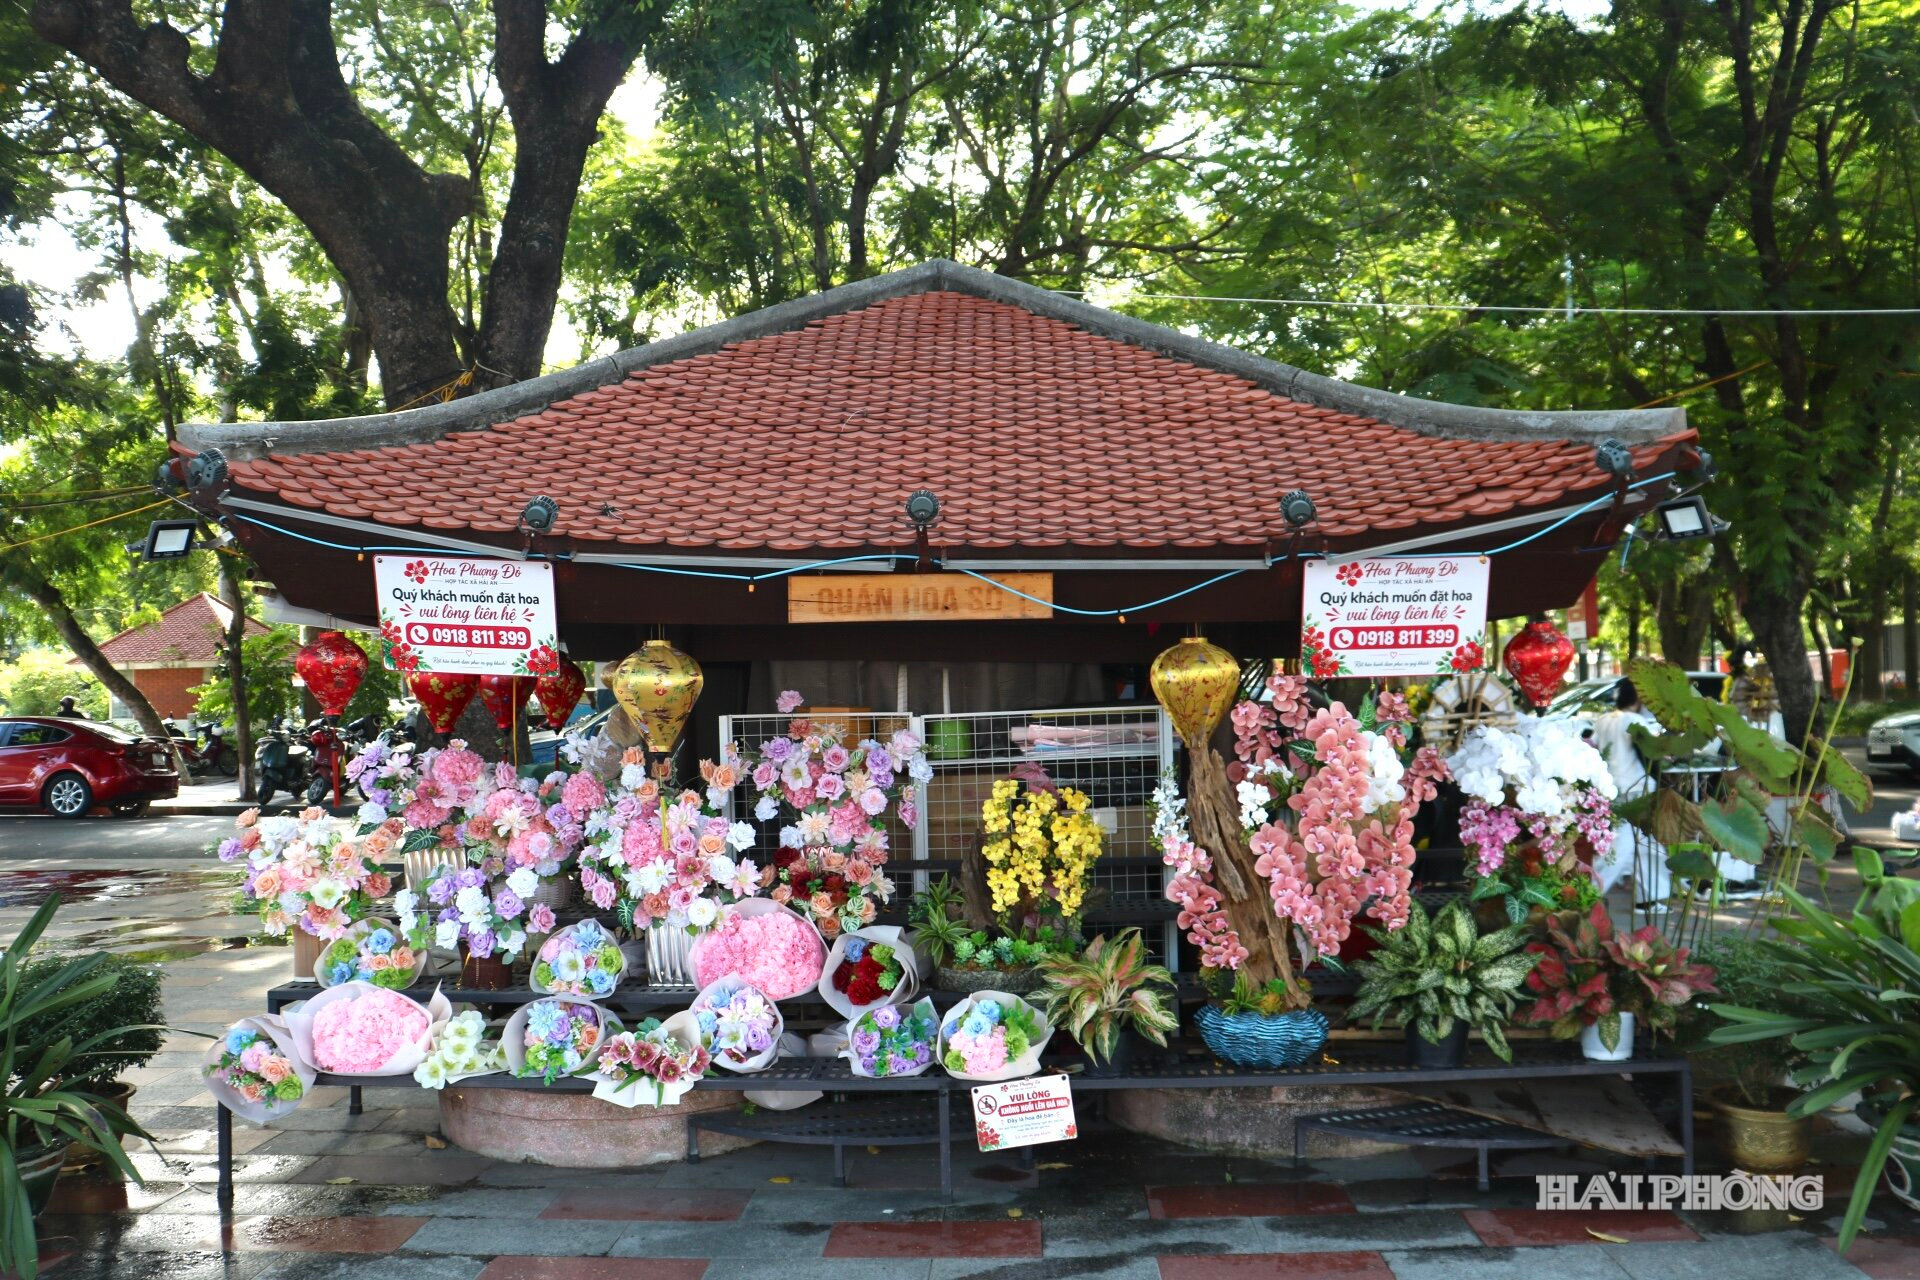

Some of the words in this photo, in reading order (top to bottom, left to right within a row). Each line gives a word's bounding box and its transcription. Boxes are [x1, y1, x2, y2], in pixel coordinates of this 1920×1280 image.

[429, 561, 456, 576] Hoa
[501, 563, 521, 579] Đỏ
[1364, 561, 1391, 577] Hoa
[1438, 560, 1458, 576] Đỏ
[392, 587, 418, 603] Quý
[420, 588, 457, 602] khách
[460, 590, 492, 603] muốn
[496, 591, 515, 606] đặt
[518, 592, 540, 605] hoa
[903, 586, 959, 614] HOA
[1320, 591, 1347, 606] Quý
[1350, 590, 1389, 604] khách
[1392, 589, 1426, 602] muốn
[1429, 590, 1448, 605] đặt
[1451, 590, 1472, 601] hoa
[419, 605, 438, 618] vui
[441, 603, 471, 623] lòng
[474, 605, 497, 620] liên
[497, 606, 517, 624] hệ
[1346, 608, 1368, 621] vui
[1370, 605, 1400, 624] lòng
[1404, 605, 1429, 620] liên
[1431, 604, 1448, 622] hệ
[432, 628, 468, 644] 0918
[471, 630, 495, 645] 811
[498, 630, 527, 645] 399
[1357, 630, 1395, 646] 0918
[1398, 629, 1422, 645] 811
[1425, 628, 1455, 644] 399
[1009, 1093, 1024, 1103] VUI
[1027, 1090, 1051, 1100] LÒNG
